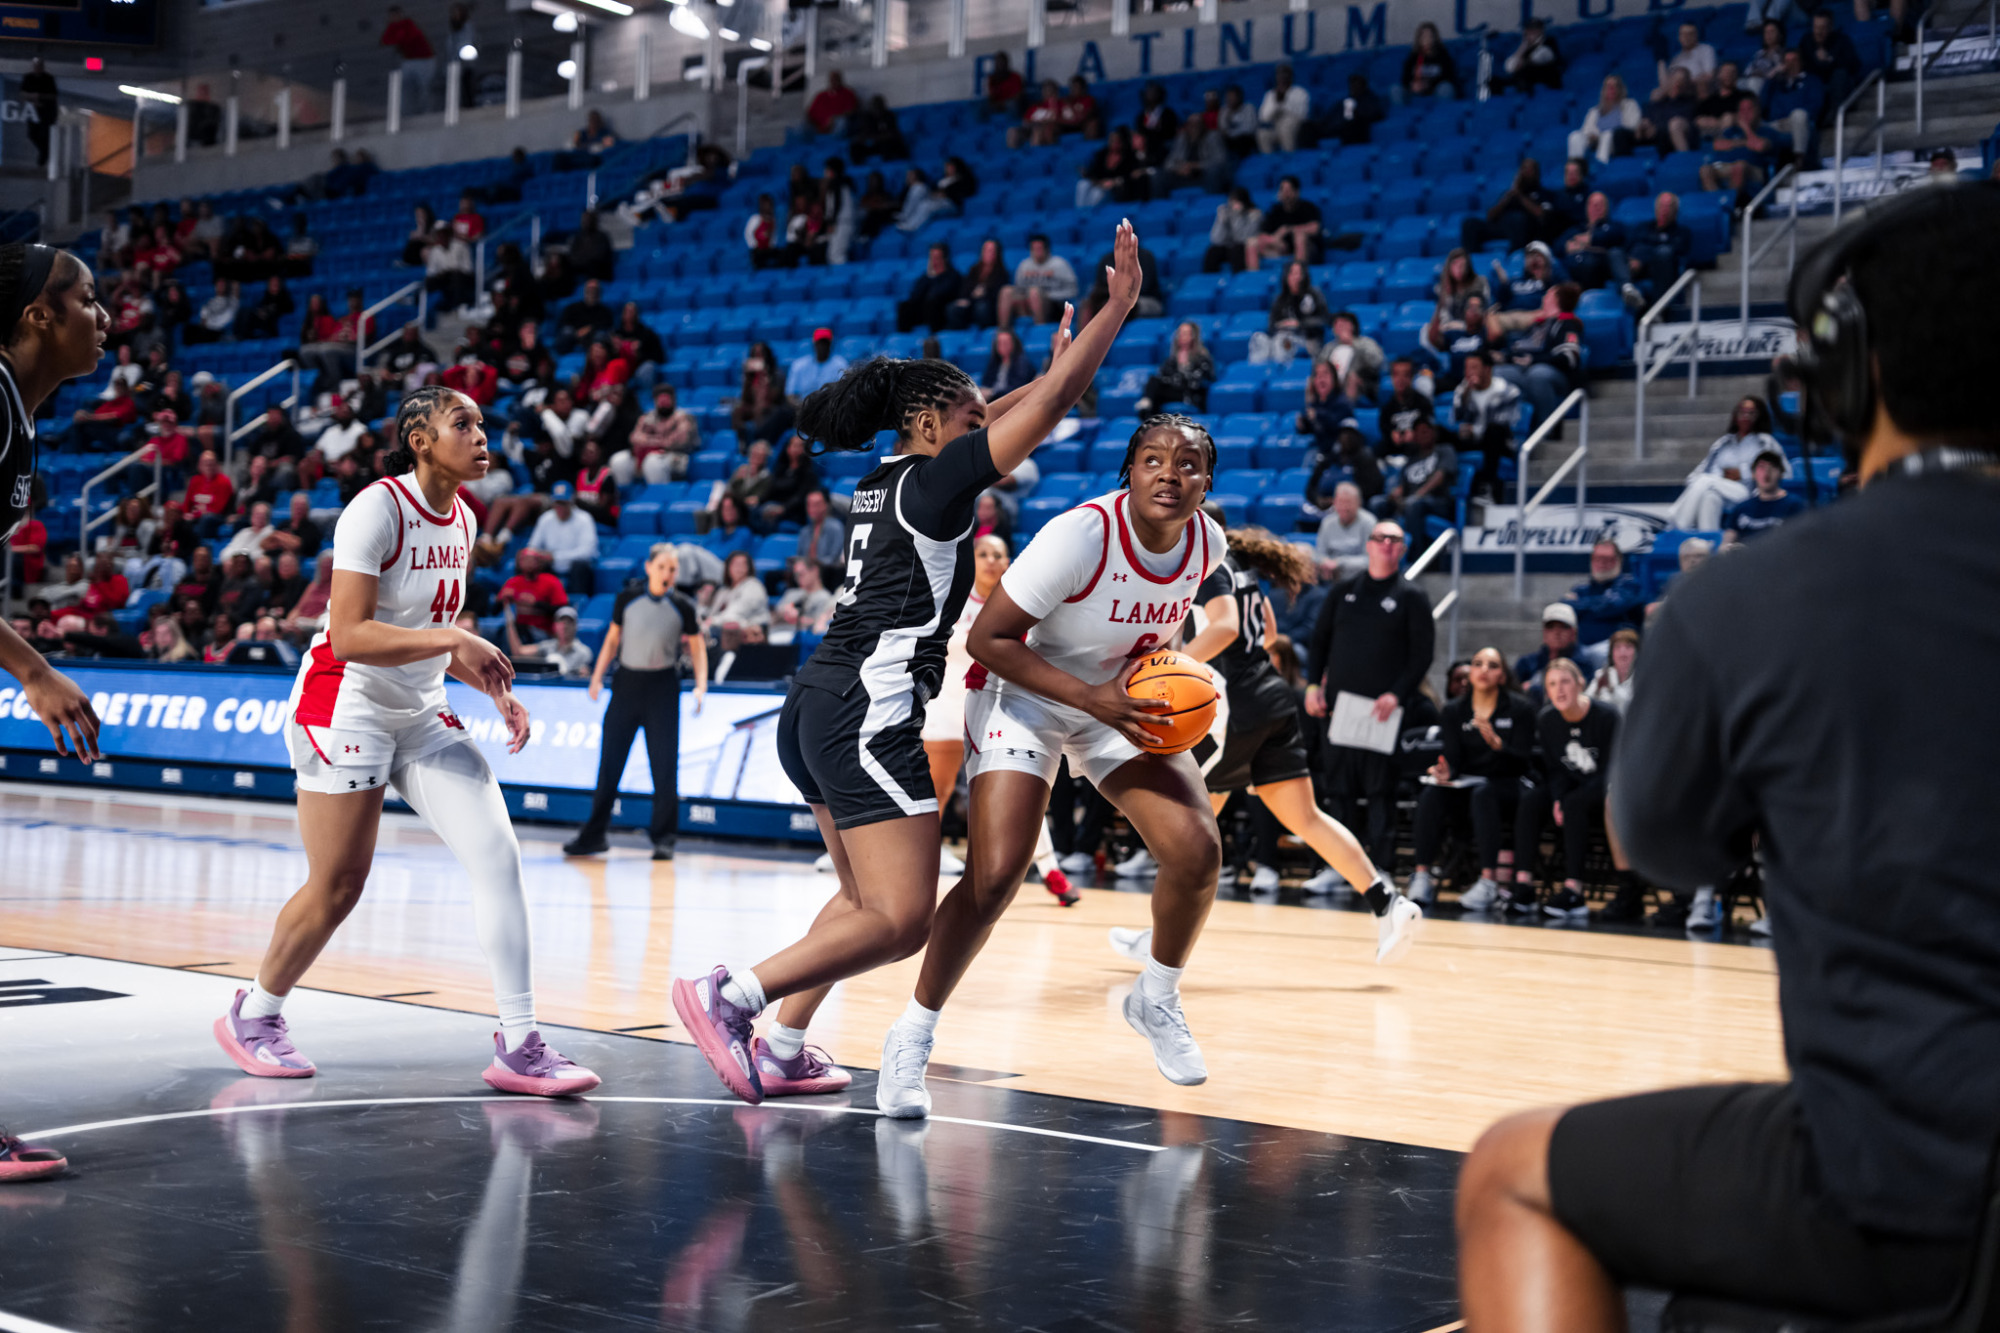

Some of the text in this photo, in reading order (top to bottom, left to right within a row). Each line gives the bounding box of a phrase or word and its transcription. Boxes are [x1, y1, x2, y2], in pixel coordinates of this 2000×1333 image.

[974, 3, 1387, 96] PLATINUM
[837, 523, 873, 606] 5
[430, 578, 460, 623] 44
[90, 691, 207, 730] BETTER
[213, 698, 290, 735] COU
[552, 720, 602, 749] 202
